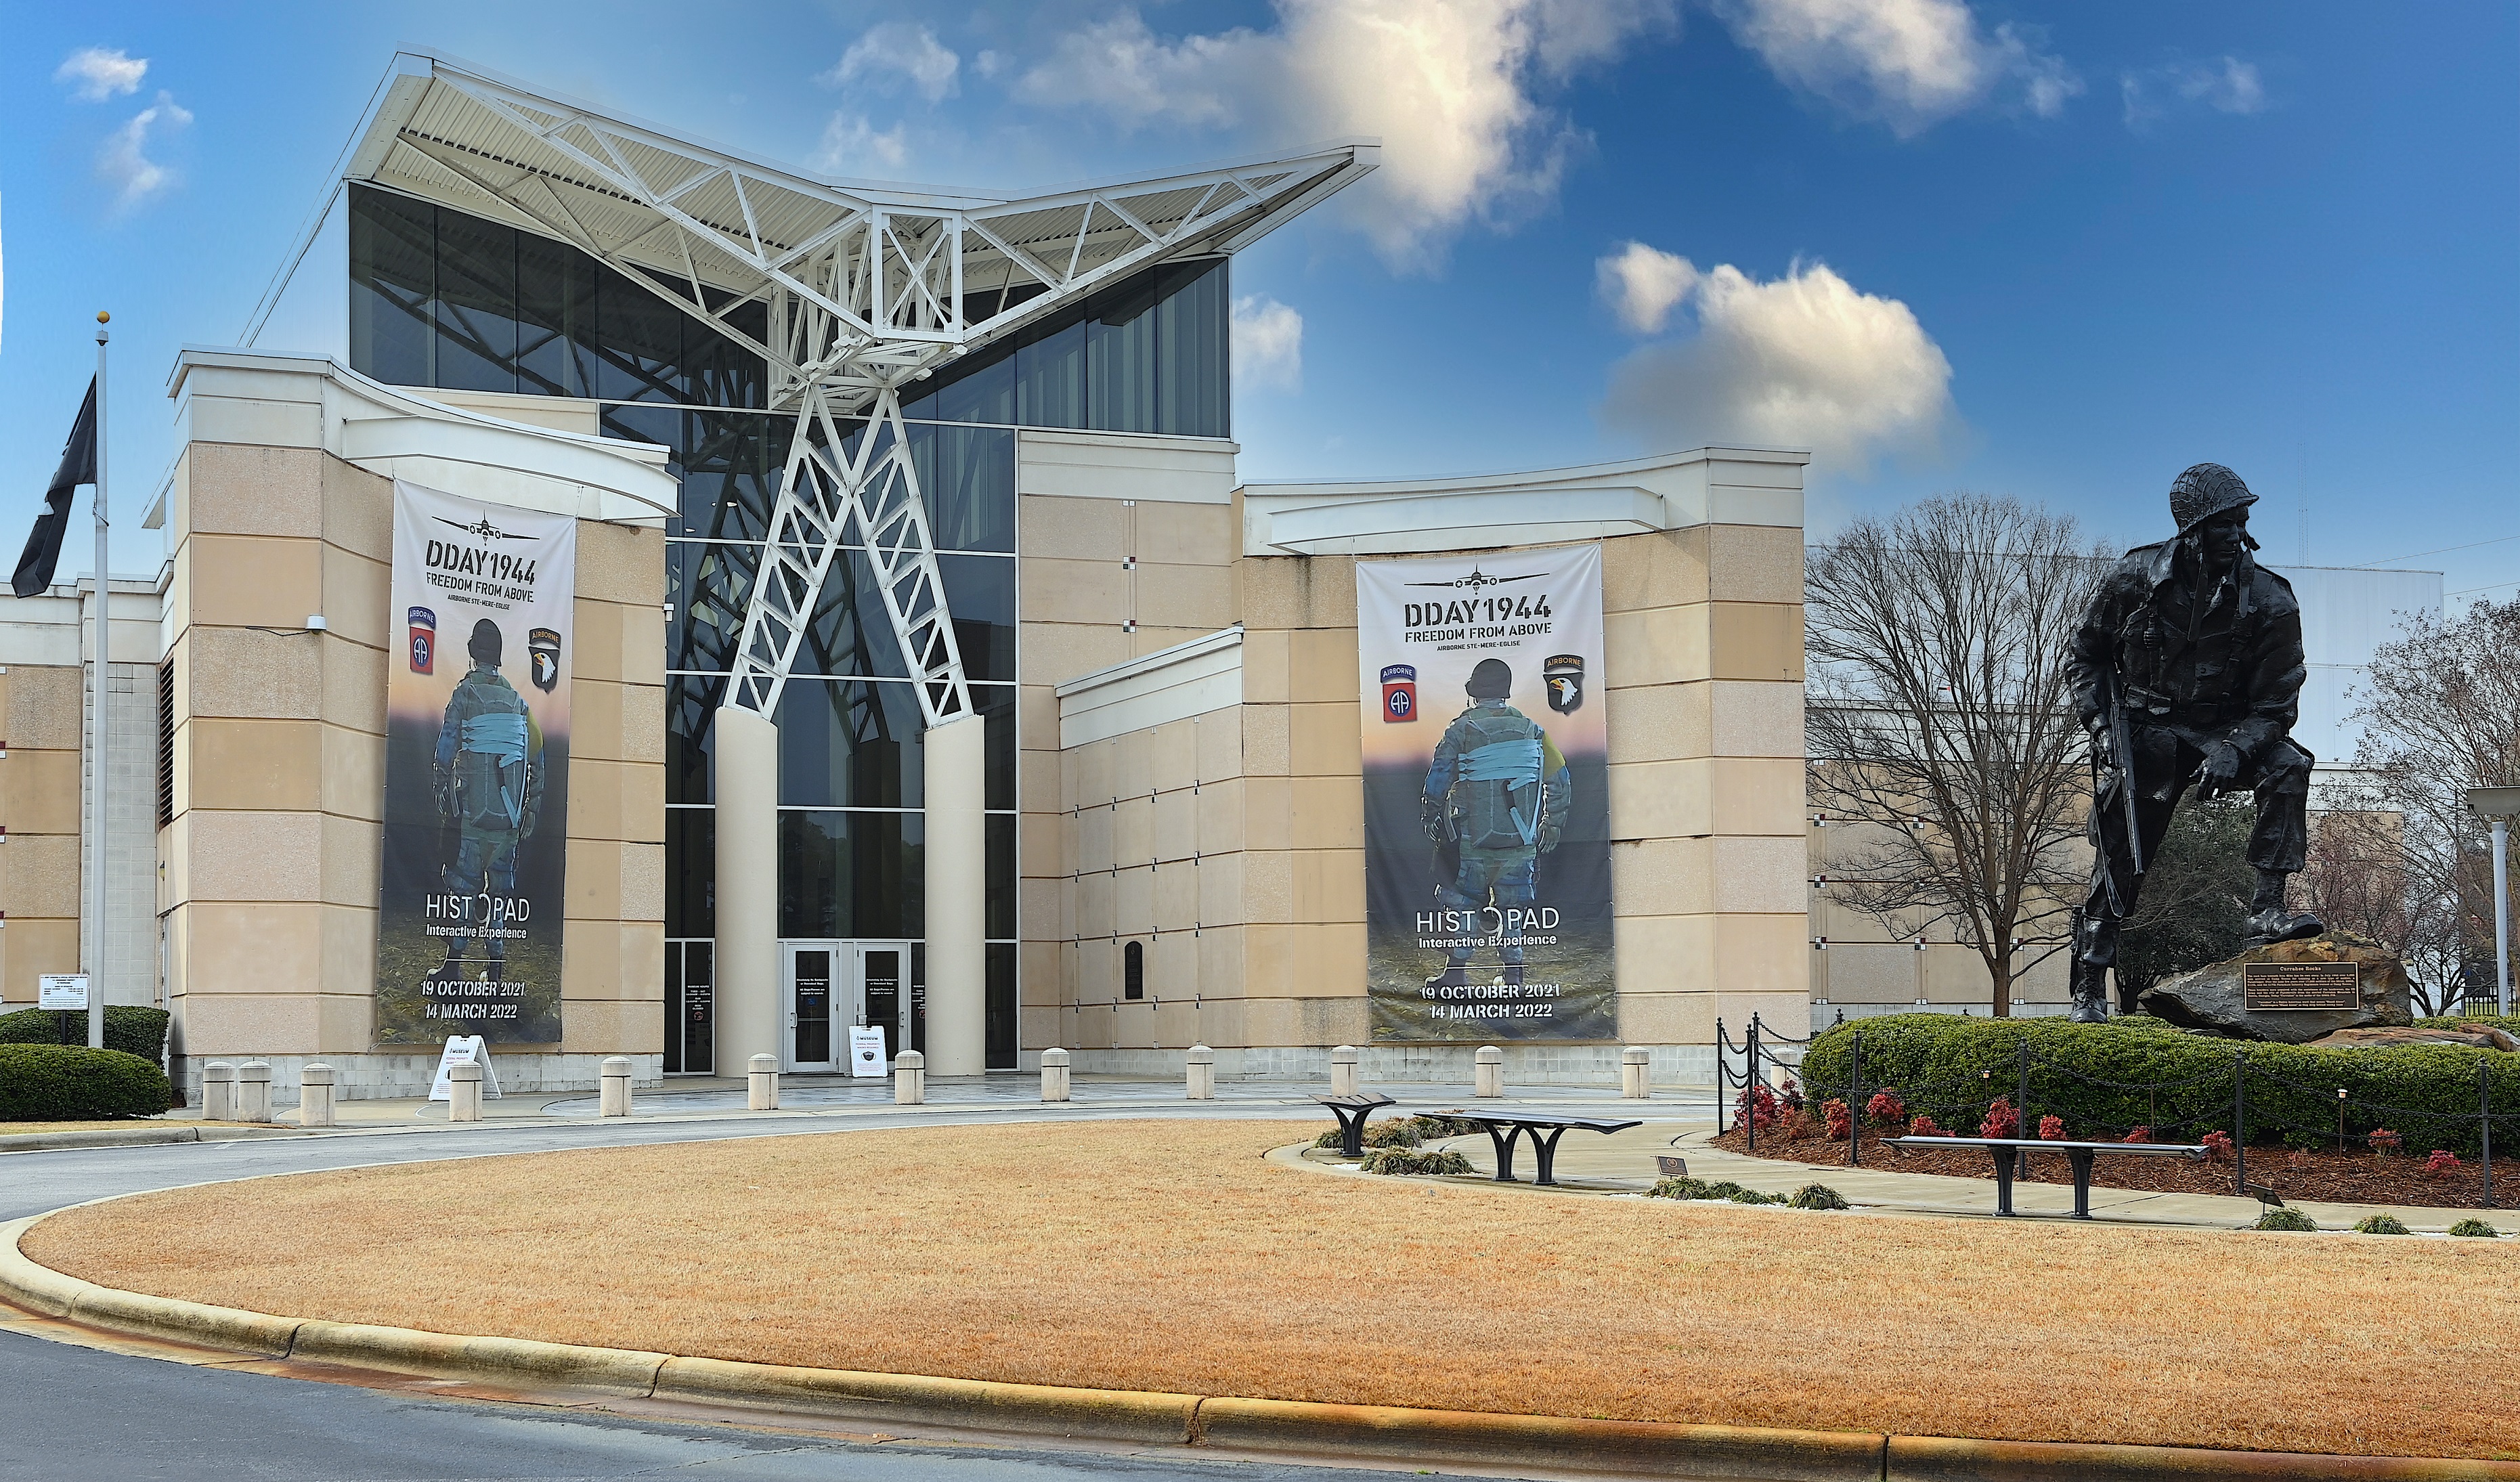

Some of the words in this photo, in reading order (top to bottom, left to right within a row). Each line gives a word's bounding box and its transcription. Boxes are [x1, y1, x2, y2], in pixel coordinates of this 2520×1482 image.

[426, 540, 488, 575] DDAY
[491, 552, 536, 585] 1944
[427, 571, 473, 592] FREEDOM
[475, 581, 502, 598] FROM
[504, 587, 534, 603] ABOVE
[448, 594, 471, 603] AIRBORNE
[471, 598, 510, 611] STE-MERE-EGLISE
[409, 609, 435, 624] AIRBORNE
[1405, 599, 1480, 628] DDAY
[1483, 594, 1552, 621] 1944
[531, 630, 559, 644] AIRBORNE
[1405, 628, 1465, 642] FREEDOM
[1469, 626, 1504, 639] FROM
[1508, 622, 1552, 636] ABOVE
[1467, 640, 1521, 649] STE-MERE-EGLISE
[1547, 657, 1582, 668] AIRBORNE
[1383, 667, 1413, 678] AIRBORNE
[426, 923, 477, 937] Interactive
[478, 925, 527, 940] Experience
[1418, 936, 1485, 949] Interactive
[1488, 934, 1557, 948] Experience
[420, 980, 434, 997] 19
[437, 980, 498, 997] OCTOBER
[500, 982, 525, 997] 2021
[1419, 986, 1435, 999] 19
[1440, 984, 1520, 999] OCTOBER
[1525, 984, 1561, 998] 2021
[425, 1003, 438, 1019] 14
[441, 1003, 487, 1019] MARCH
[490, 1004, 518, 1019] 2022
[1429, 1005, 1446, 1019] 14
[1450, 1004, 1510, 1019] MARCH
[1515, 1003, 1552, 1018] 2022
